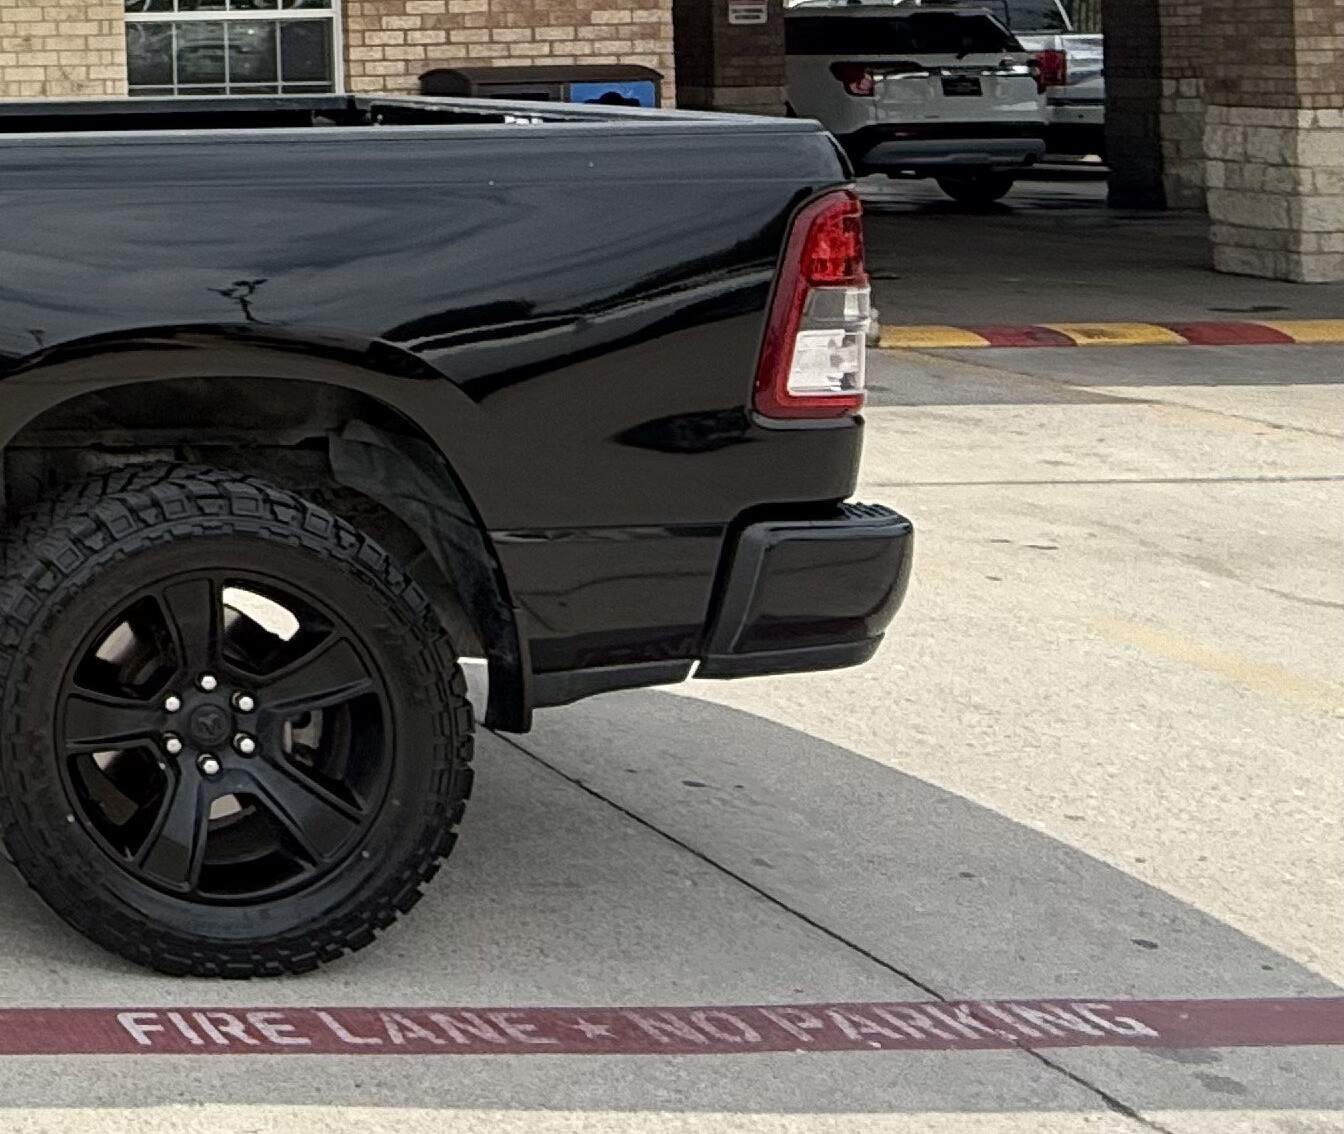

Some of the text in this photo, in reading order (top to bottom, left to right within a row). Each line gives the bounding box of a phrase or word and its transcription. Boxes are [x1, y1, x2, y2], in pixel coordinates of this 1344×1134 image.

[115, 1002, 1159, 1046] FIRE LANE NO PARKING
